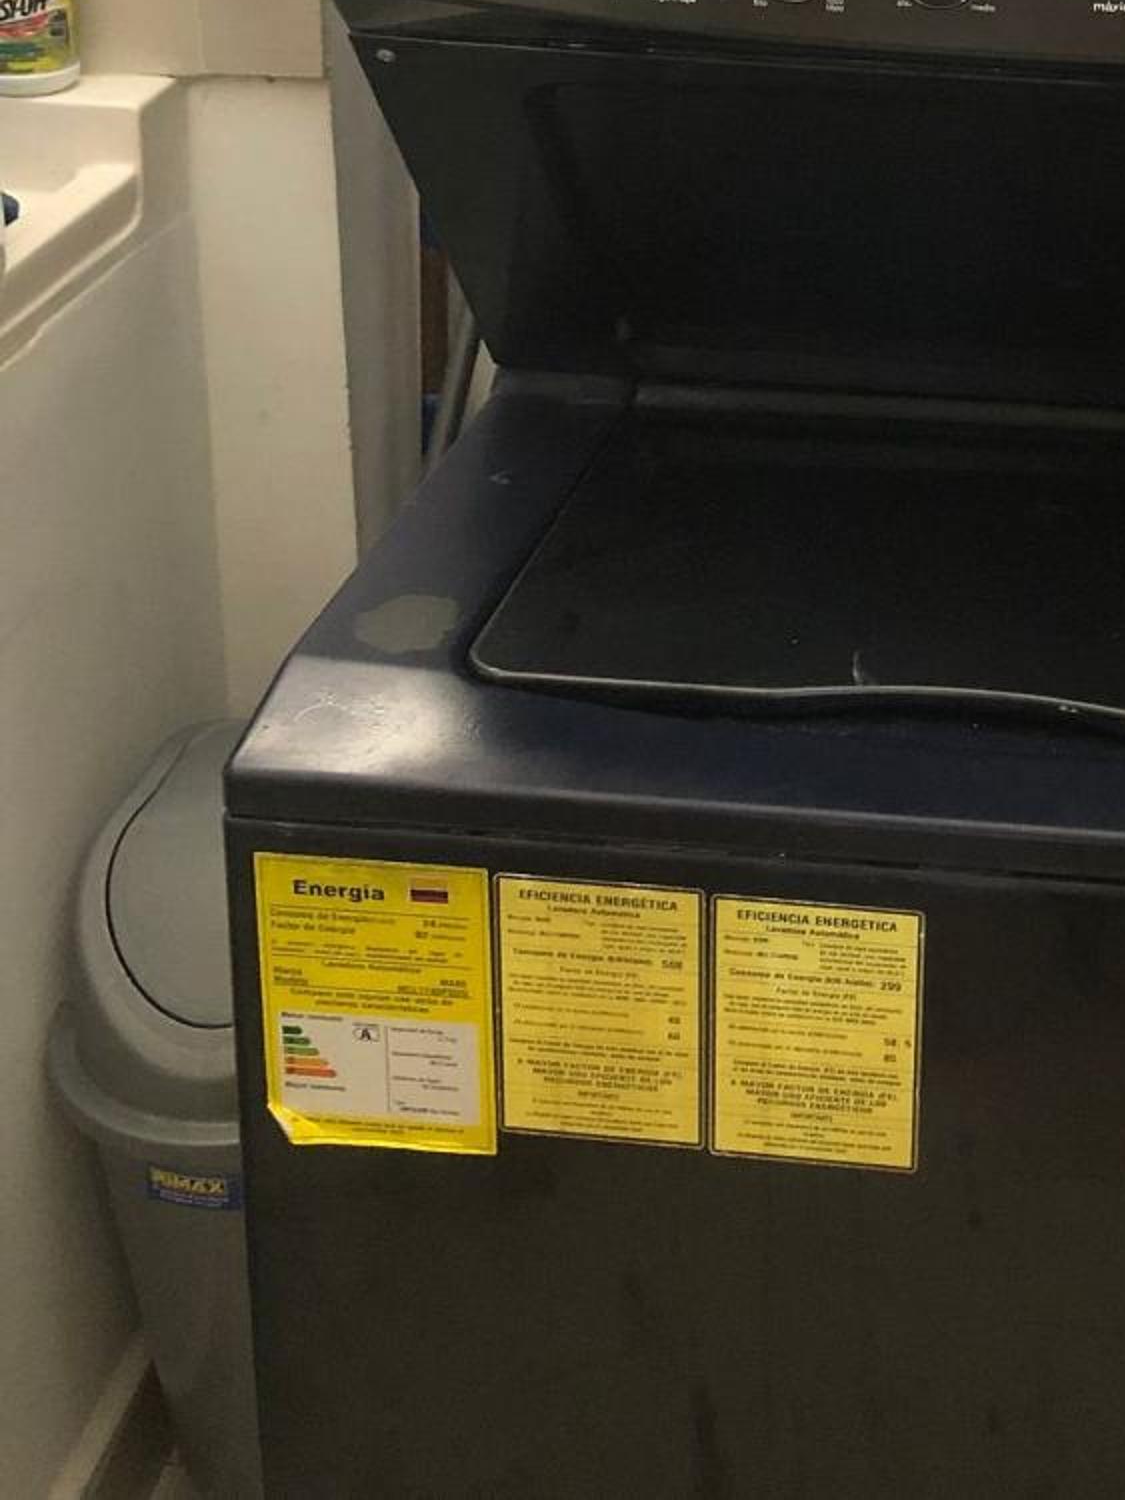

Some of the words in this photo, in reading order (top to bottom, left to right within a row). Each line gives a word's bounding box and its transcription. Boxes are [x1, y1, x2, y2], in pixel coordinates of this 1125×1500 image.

[291, 878, 386, 903] Energía
[518, 888, 591, 905] EFICIENCIA
[736, 908, 811, 927] EFICIENCIA
